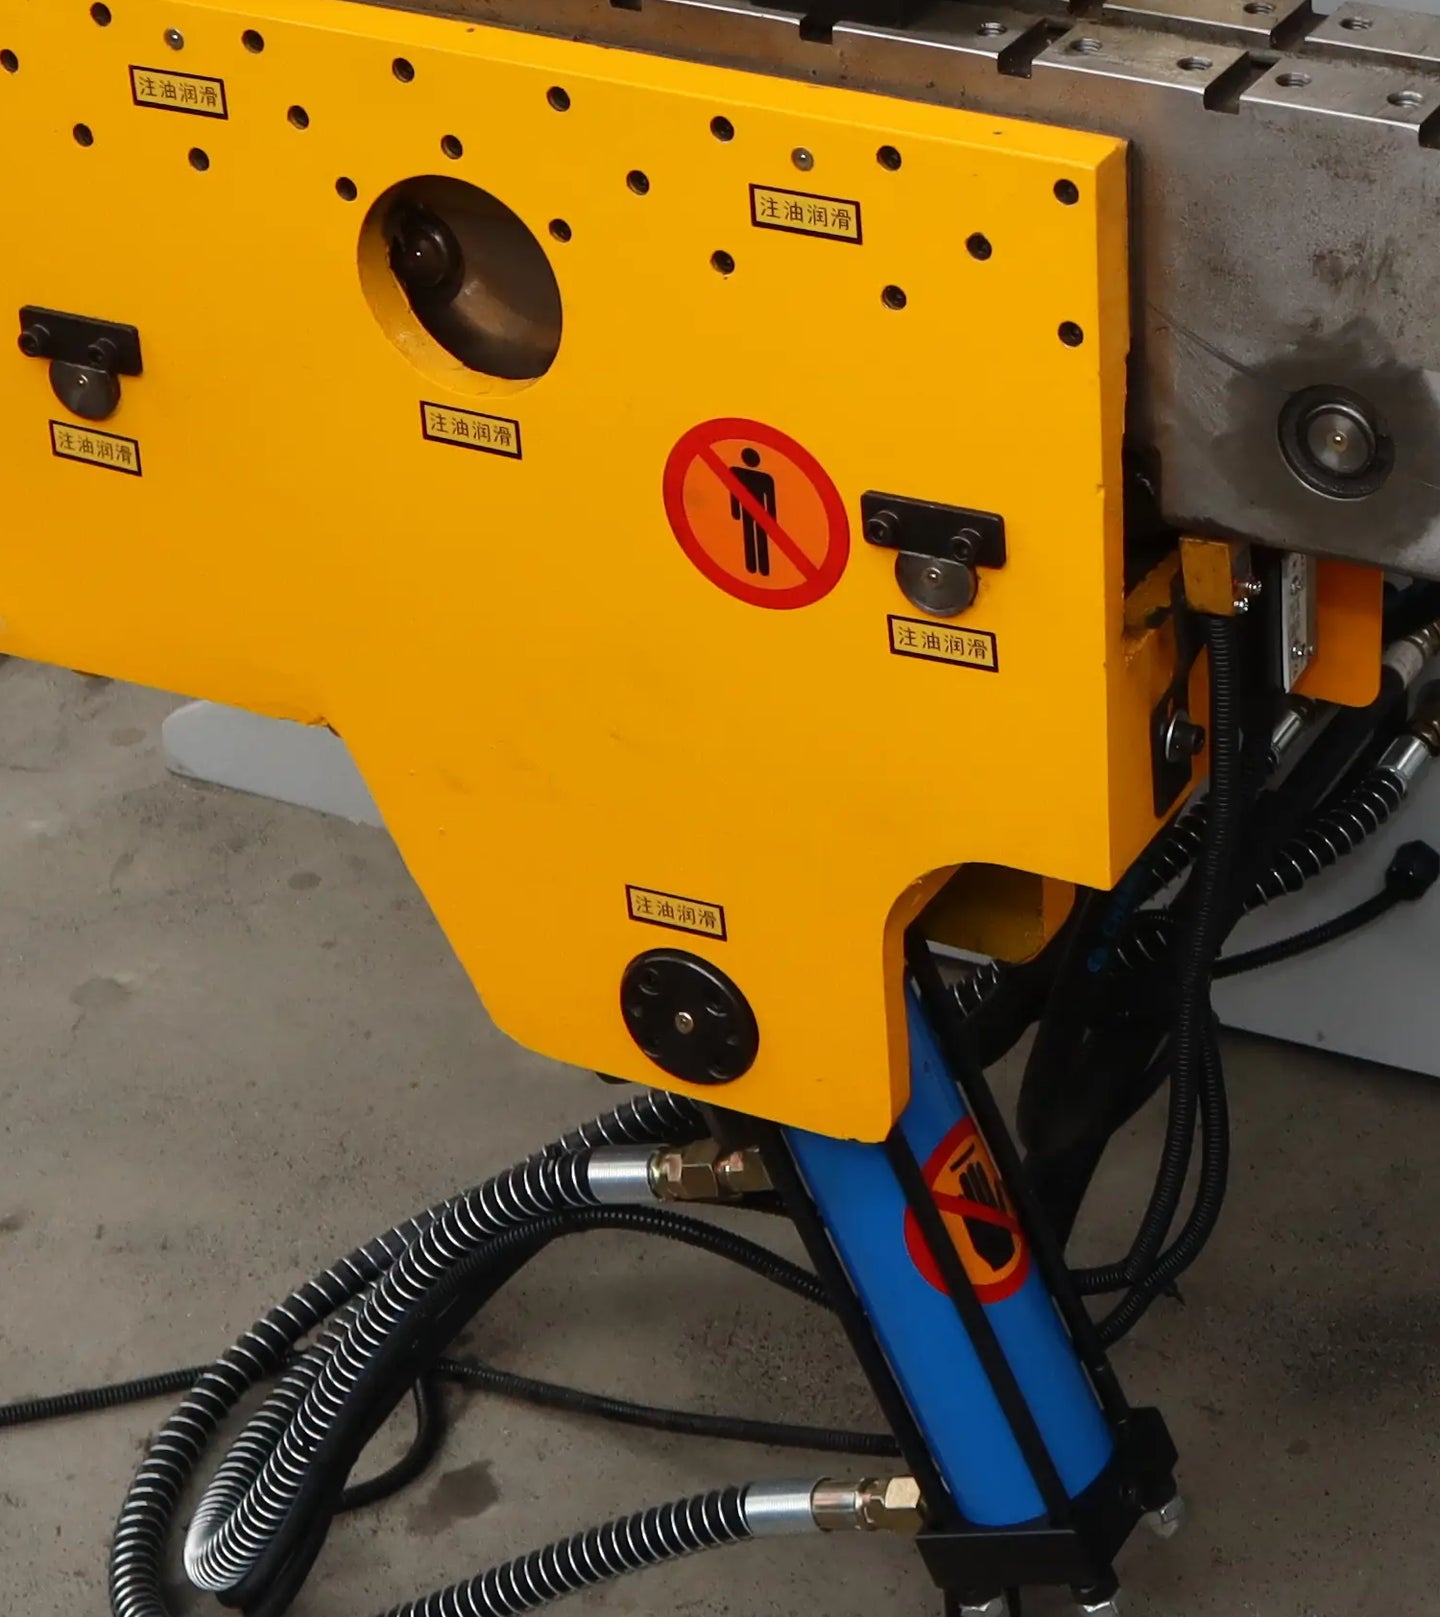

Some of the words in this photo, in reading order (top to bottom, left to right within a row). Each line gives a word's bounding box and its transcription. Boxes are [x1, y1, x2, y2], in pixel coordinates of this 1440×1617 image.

[138, 74, 219, 108] 注油润滑
[759, 194, 853, 232] 注油润滑
[57, 428, 134, 466] 注油润滑
[429, 410, 513, 448] 注油润滑
[897, 624, 989, 661] 注油润滑
[634, 893, 718, 930] 注油润滑
